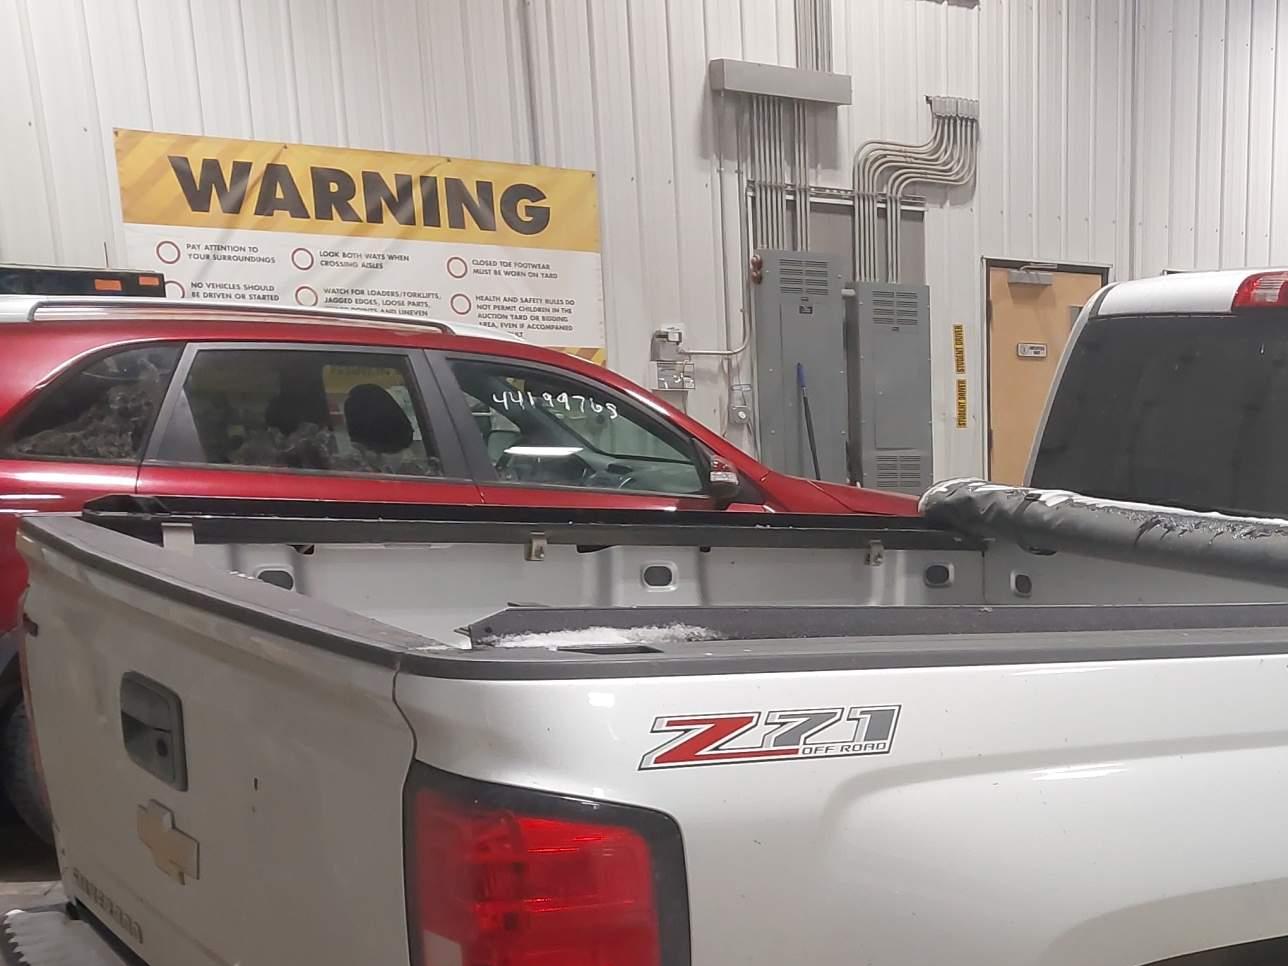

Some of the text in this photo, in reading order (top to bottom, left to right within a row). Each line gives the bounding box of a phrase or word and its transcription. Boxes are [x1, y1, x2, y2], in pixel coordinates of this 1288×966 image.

[168, 155, 551, 236] WARNING
[186, 243, 201, 251] PAY
[204, 244, 246, 253] ATTENTION
[212, 254, 276, 264] SURROUNDINGS
[319, 250, 339, 258] LOOK
[342, 251, 362, 259] BOTH
[320, 260, 359, 268] CROSSING
[472, 259, 498, 267] CLOSED
[514, 262, 550, 270] FOOTWEAR
[205, 282, 243, 290] VEHICLES
[243, 284, 275, 292] SHOULD
[381, 299, 405, 307] LOOSE
[476, 295, 501, 303] HEALTH
[398, 309, 428, 317] UNEVEN
[519, 305, 550, 313] CHILDREN
[953, 325, 965, 373] STUDENT DRIVER
[638, 704, 902, 771] Z71
[802, 742, 887, 755] OFF ROAD
